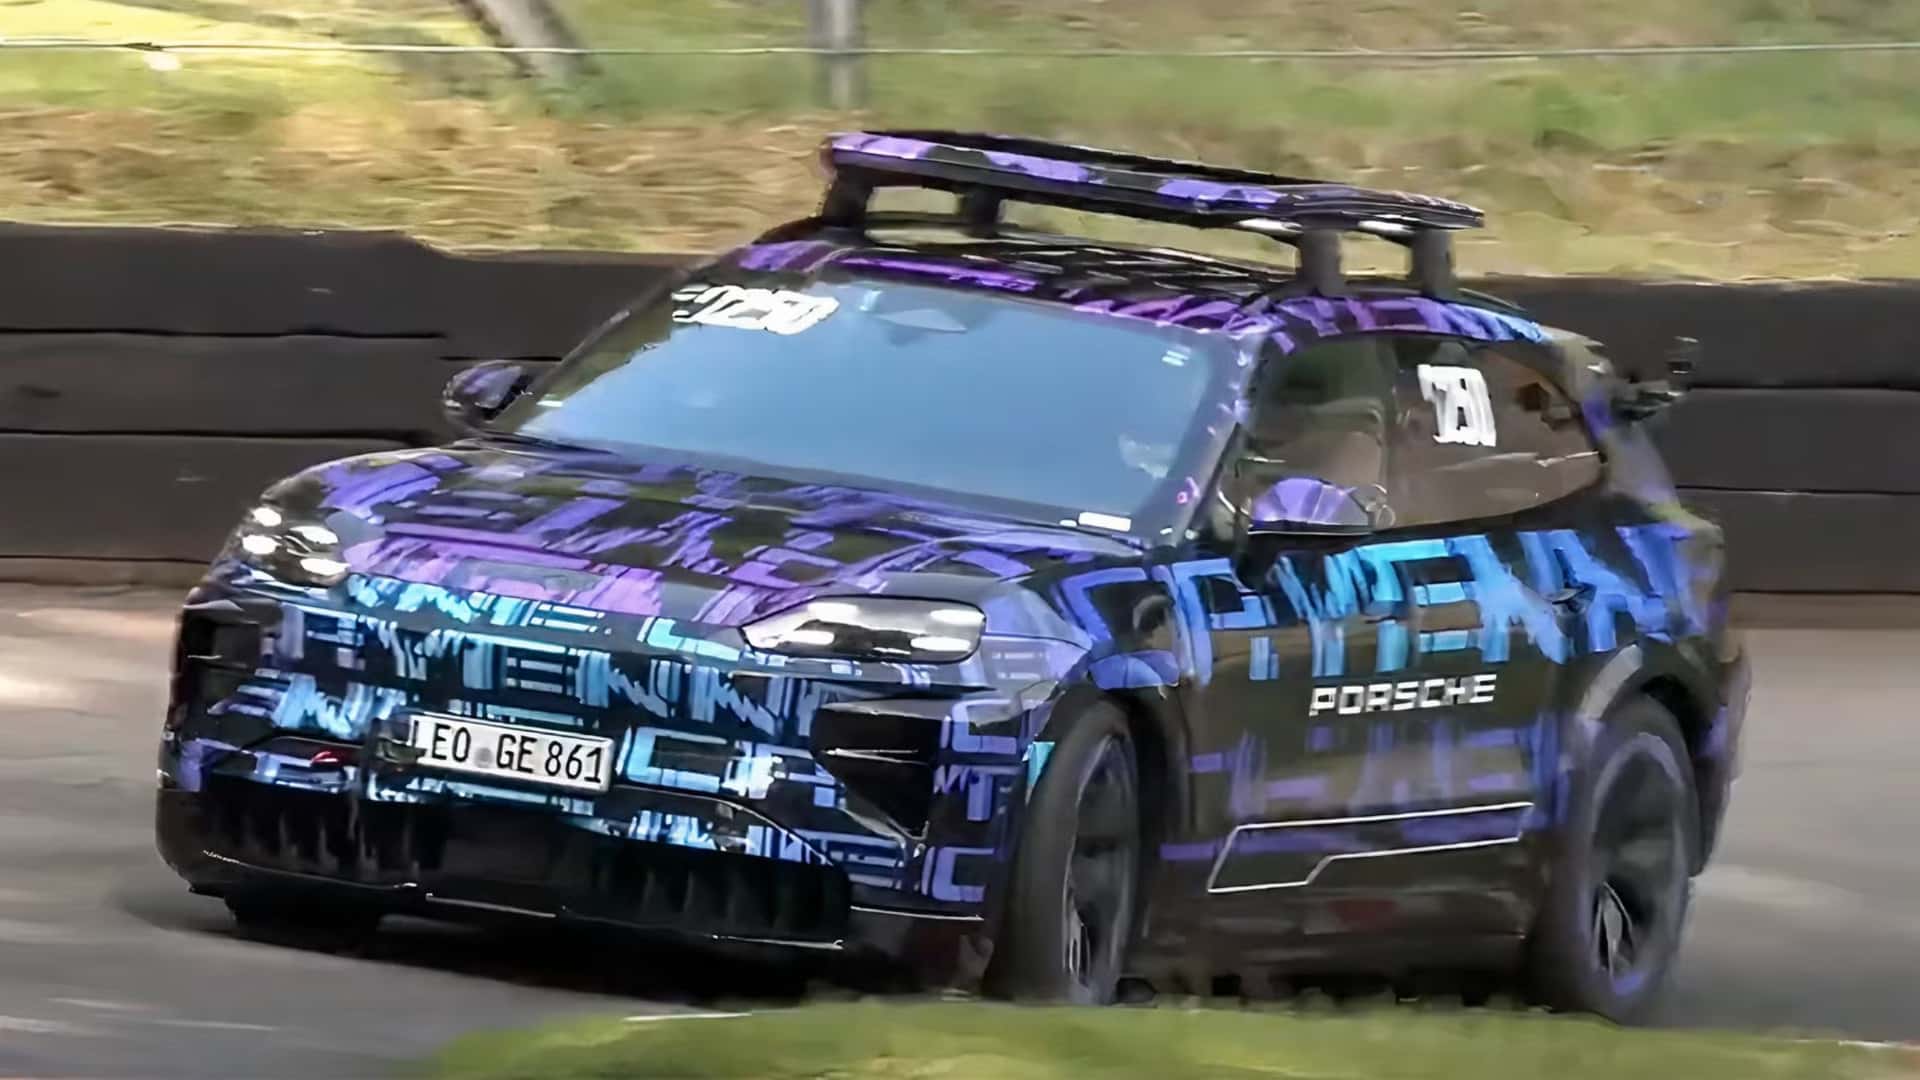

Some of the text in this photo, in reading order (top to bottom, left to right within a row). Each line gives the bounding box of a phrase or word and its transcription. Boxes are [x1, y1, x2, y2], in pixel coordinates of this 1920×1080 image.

[1309, 673, 1497, 717] PORSCHE
[496, 733, 538, 774] GE
[544, 740, 603, 784] 861
